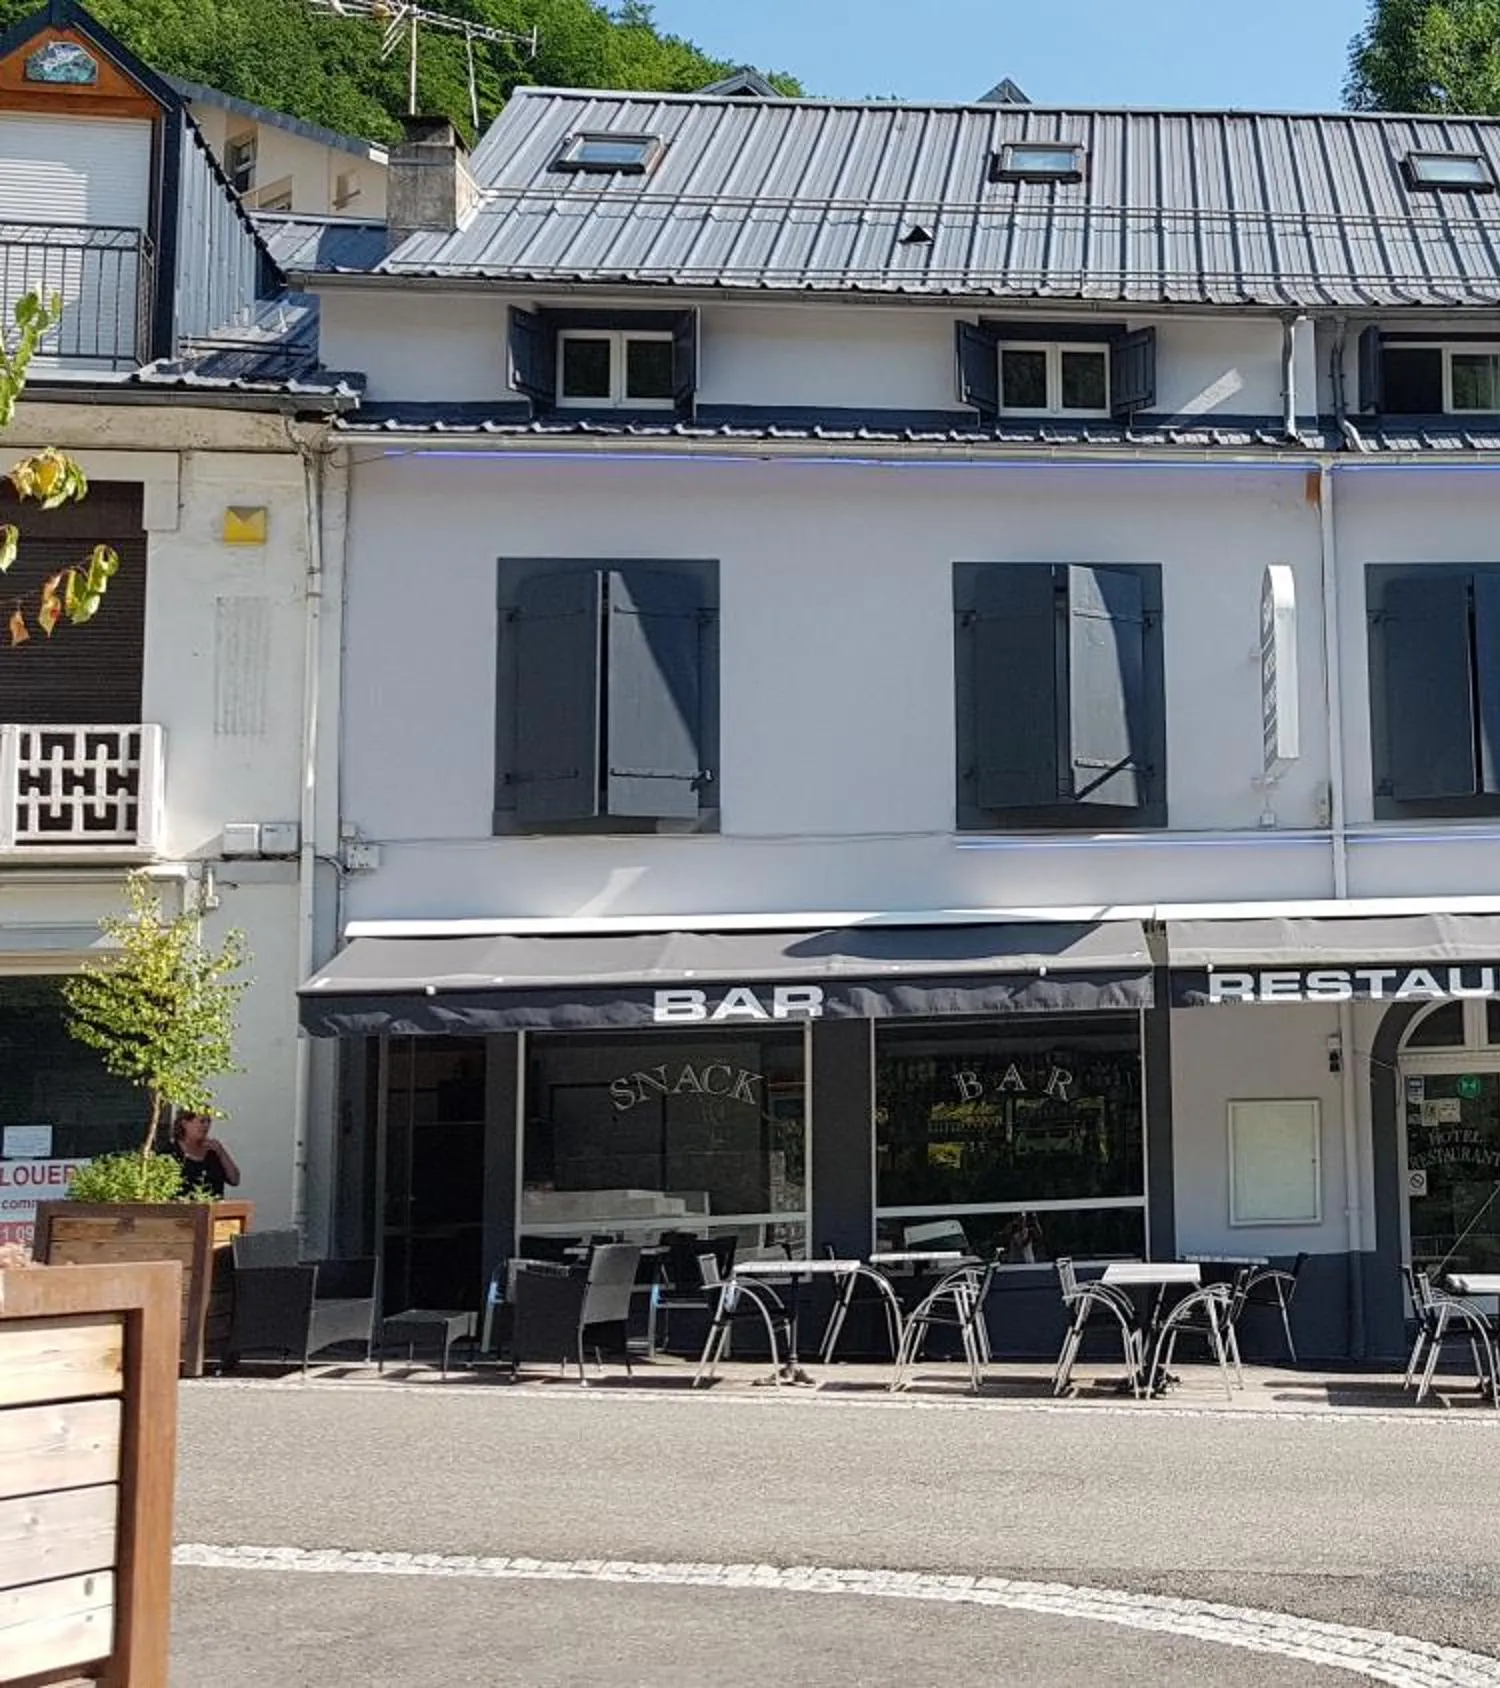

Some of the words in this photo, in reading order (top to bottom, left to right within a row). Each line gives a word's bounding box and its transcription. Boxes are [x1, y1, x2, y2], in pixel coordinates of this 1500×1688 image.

[653, 985, 825, 1022] BAR
[609, 1063, 764, 1111] SNACK
[951, 1062, 1073, 1102] BAR
